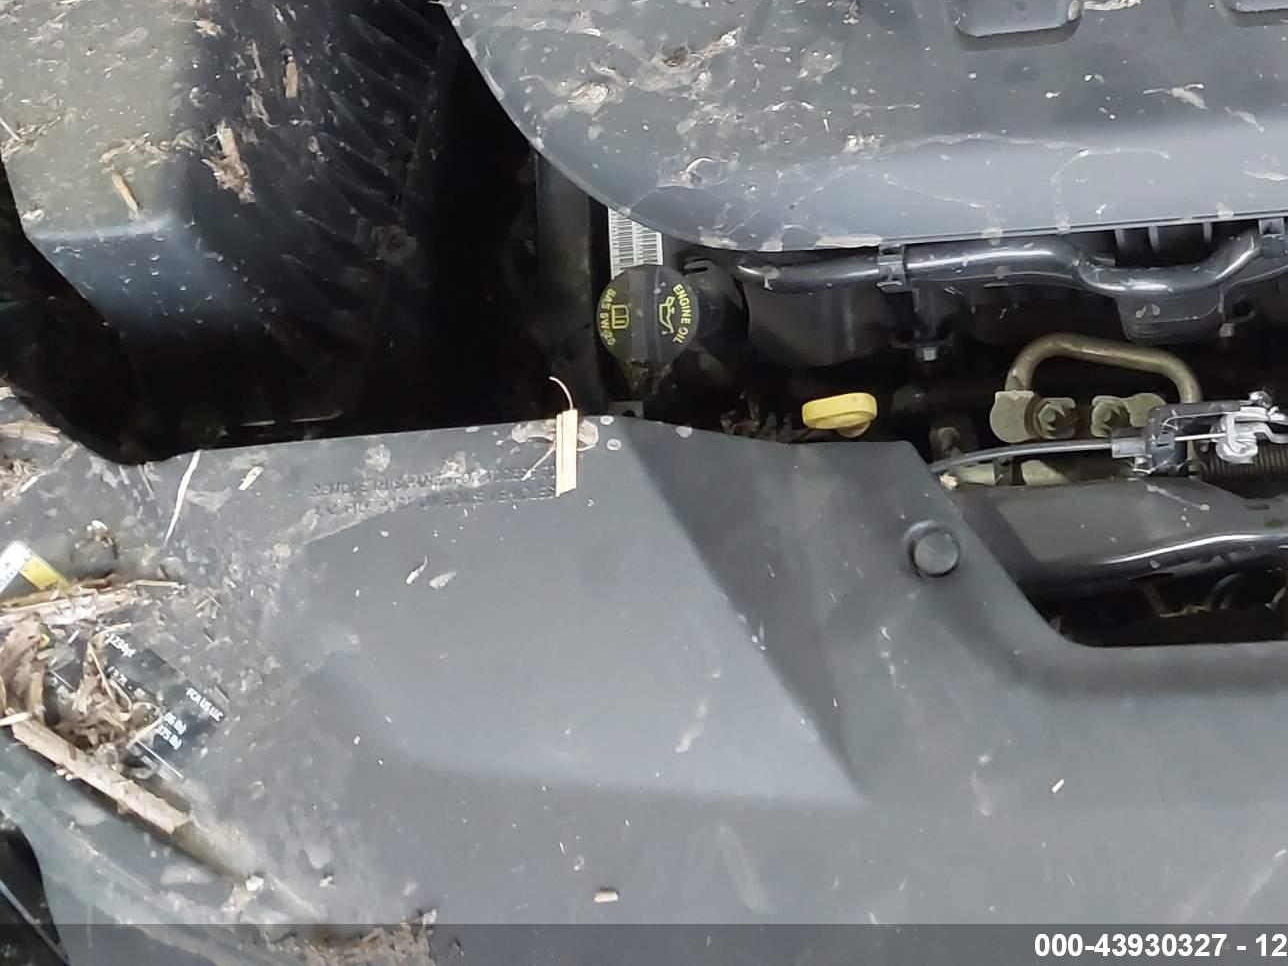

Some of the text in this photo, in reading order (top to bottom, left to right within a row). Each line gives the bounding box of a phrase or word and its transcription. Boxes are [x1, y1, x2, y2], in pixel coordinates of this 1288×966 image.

[672, 283, 692, 344] ENGINE OIL
[186, 687, 201, 704] FCA
[209, 706, 224, 721] LLC
